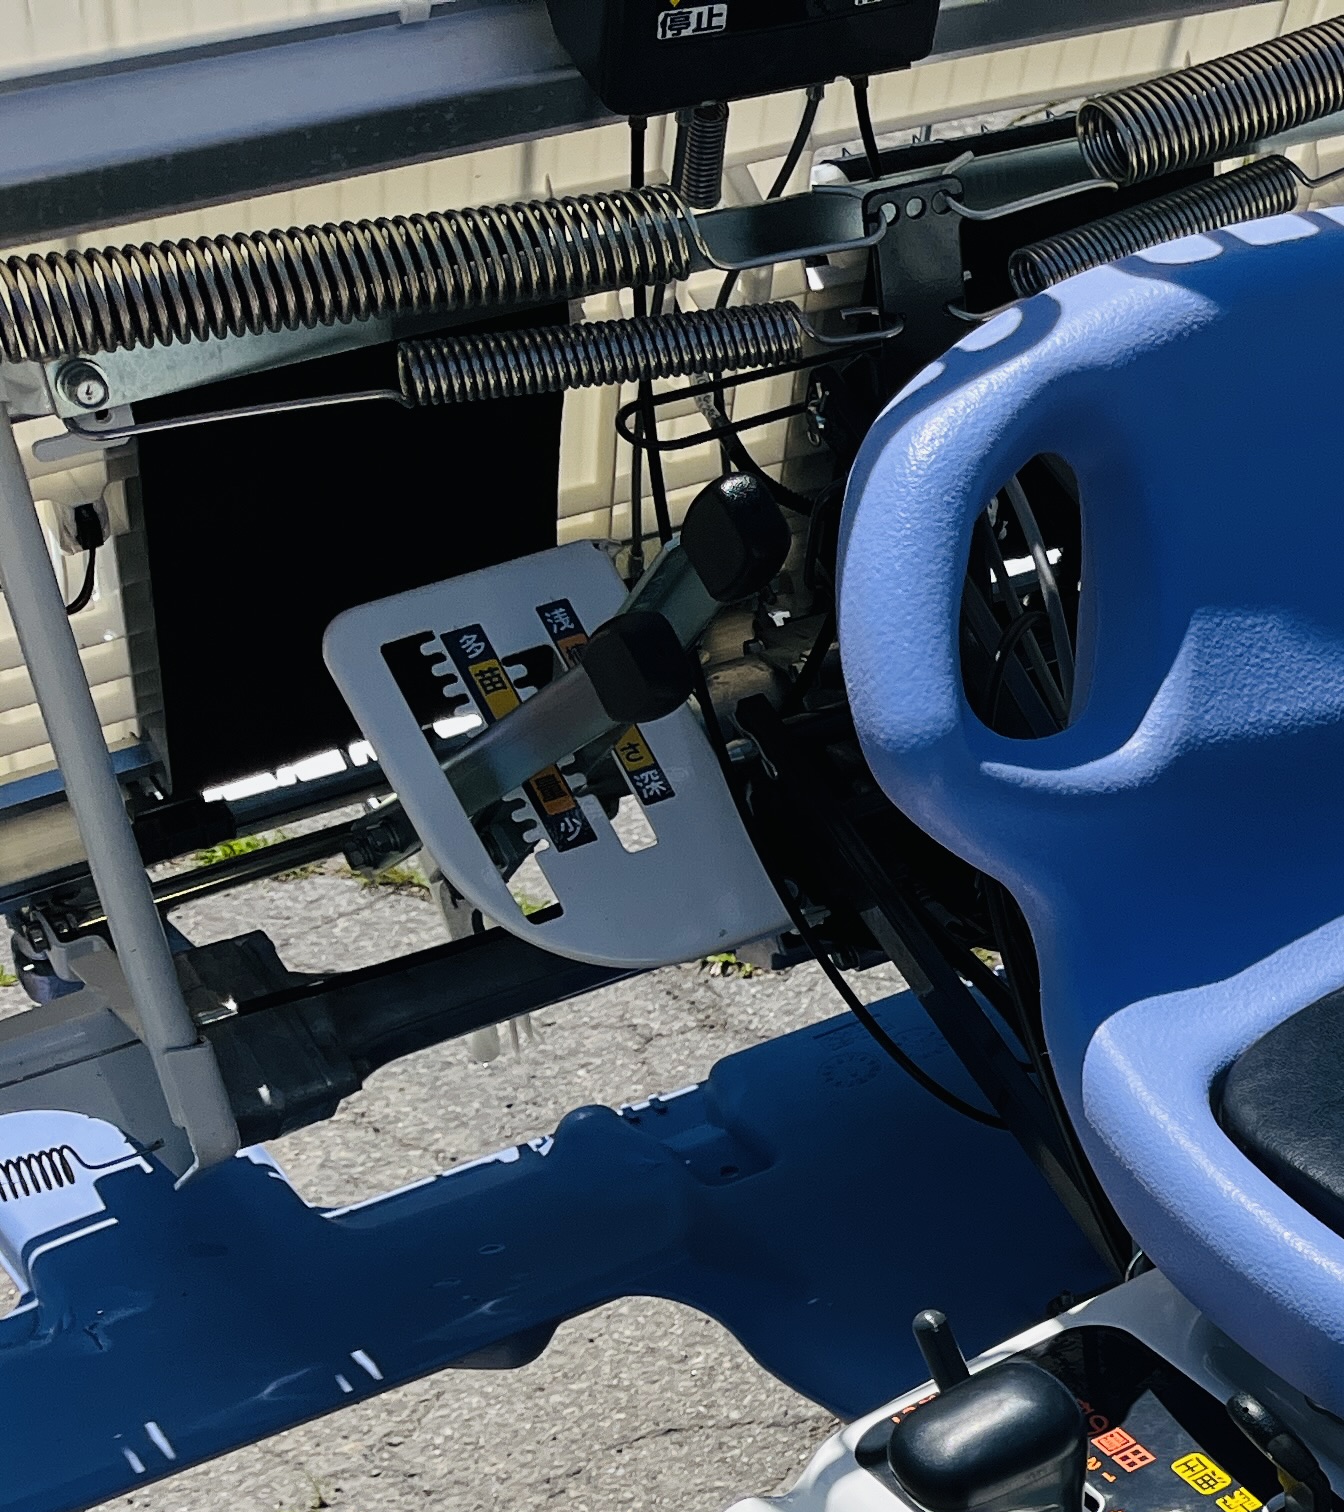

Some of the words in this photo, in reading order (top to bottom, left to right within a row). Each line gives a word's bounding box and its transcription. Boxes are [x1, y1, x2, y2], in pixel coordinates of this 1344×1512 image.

[660, 5, 726, 38] 停止
[545, 607, 575, 634] 浅
[459, 633, 485, 660] 多
[474, 666, 508, 696] 苗
[634, 768, 668, 799] 深
[560, 815, 583, 842] 少
[1175, 1455, 1228, 1494] 油圧
